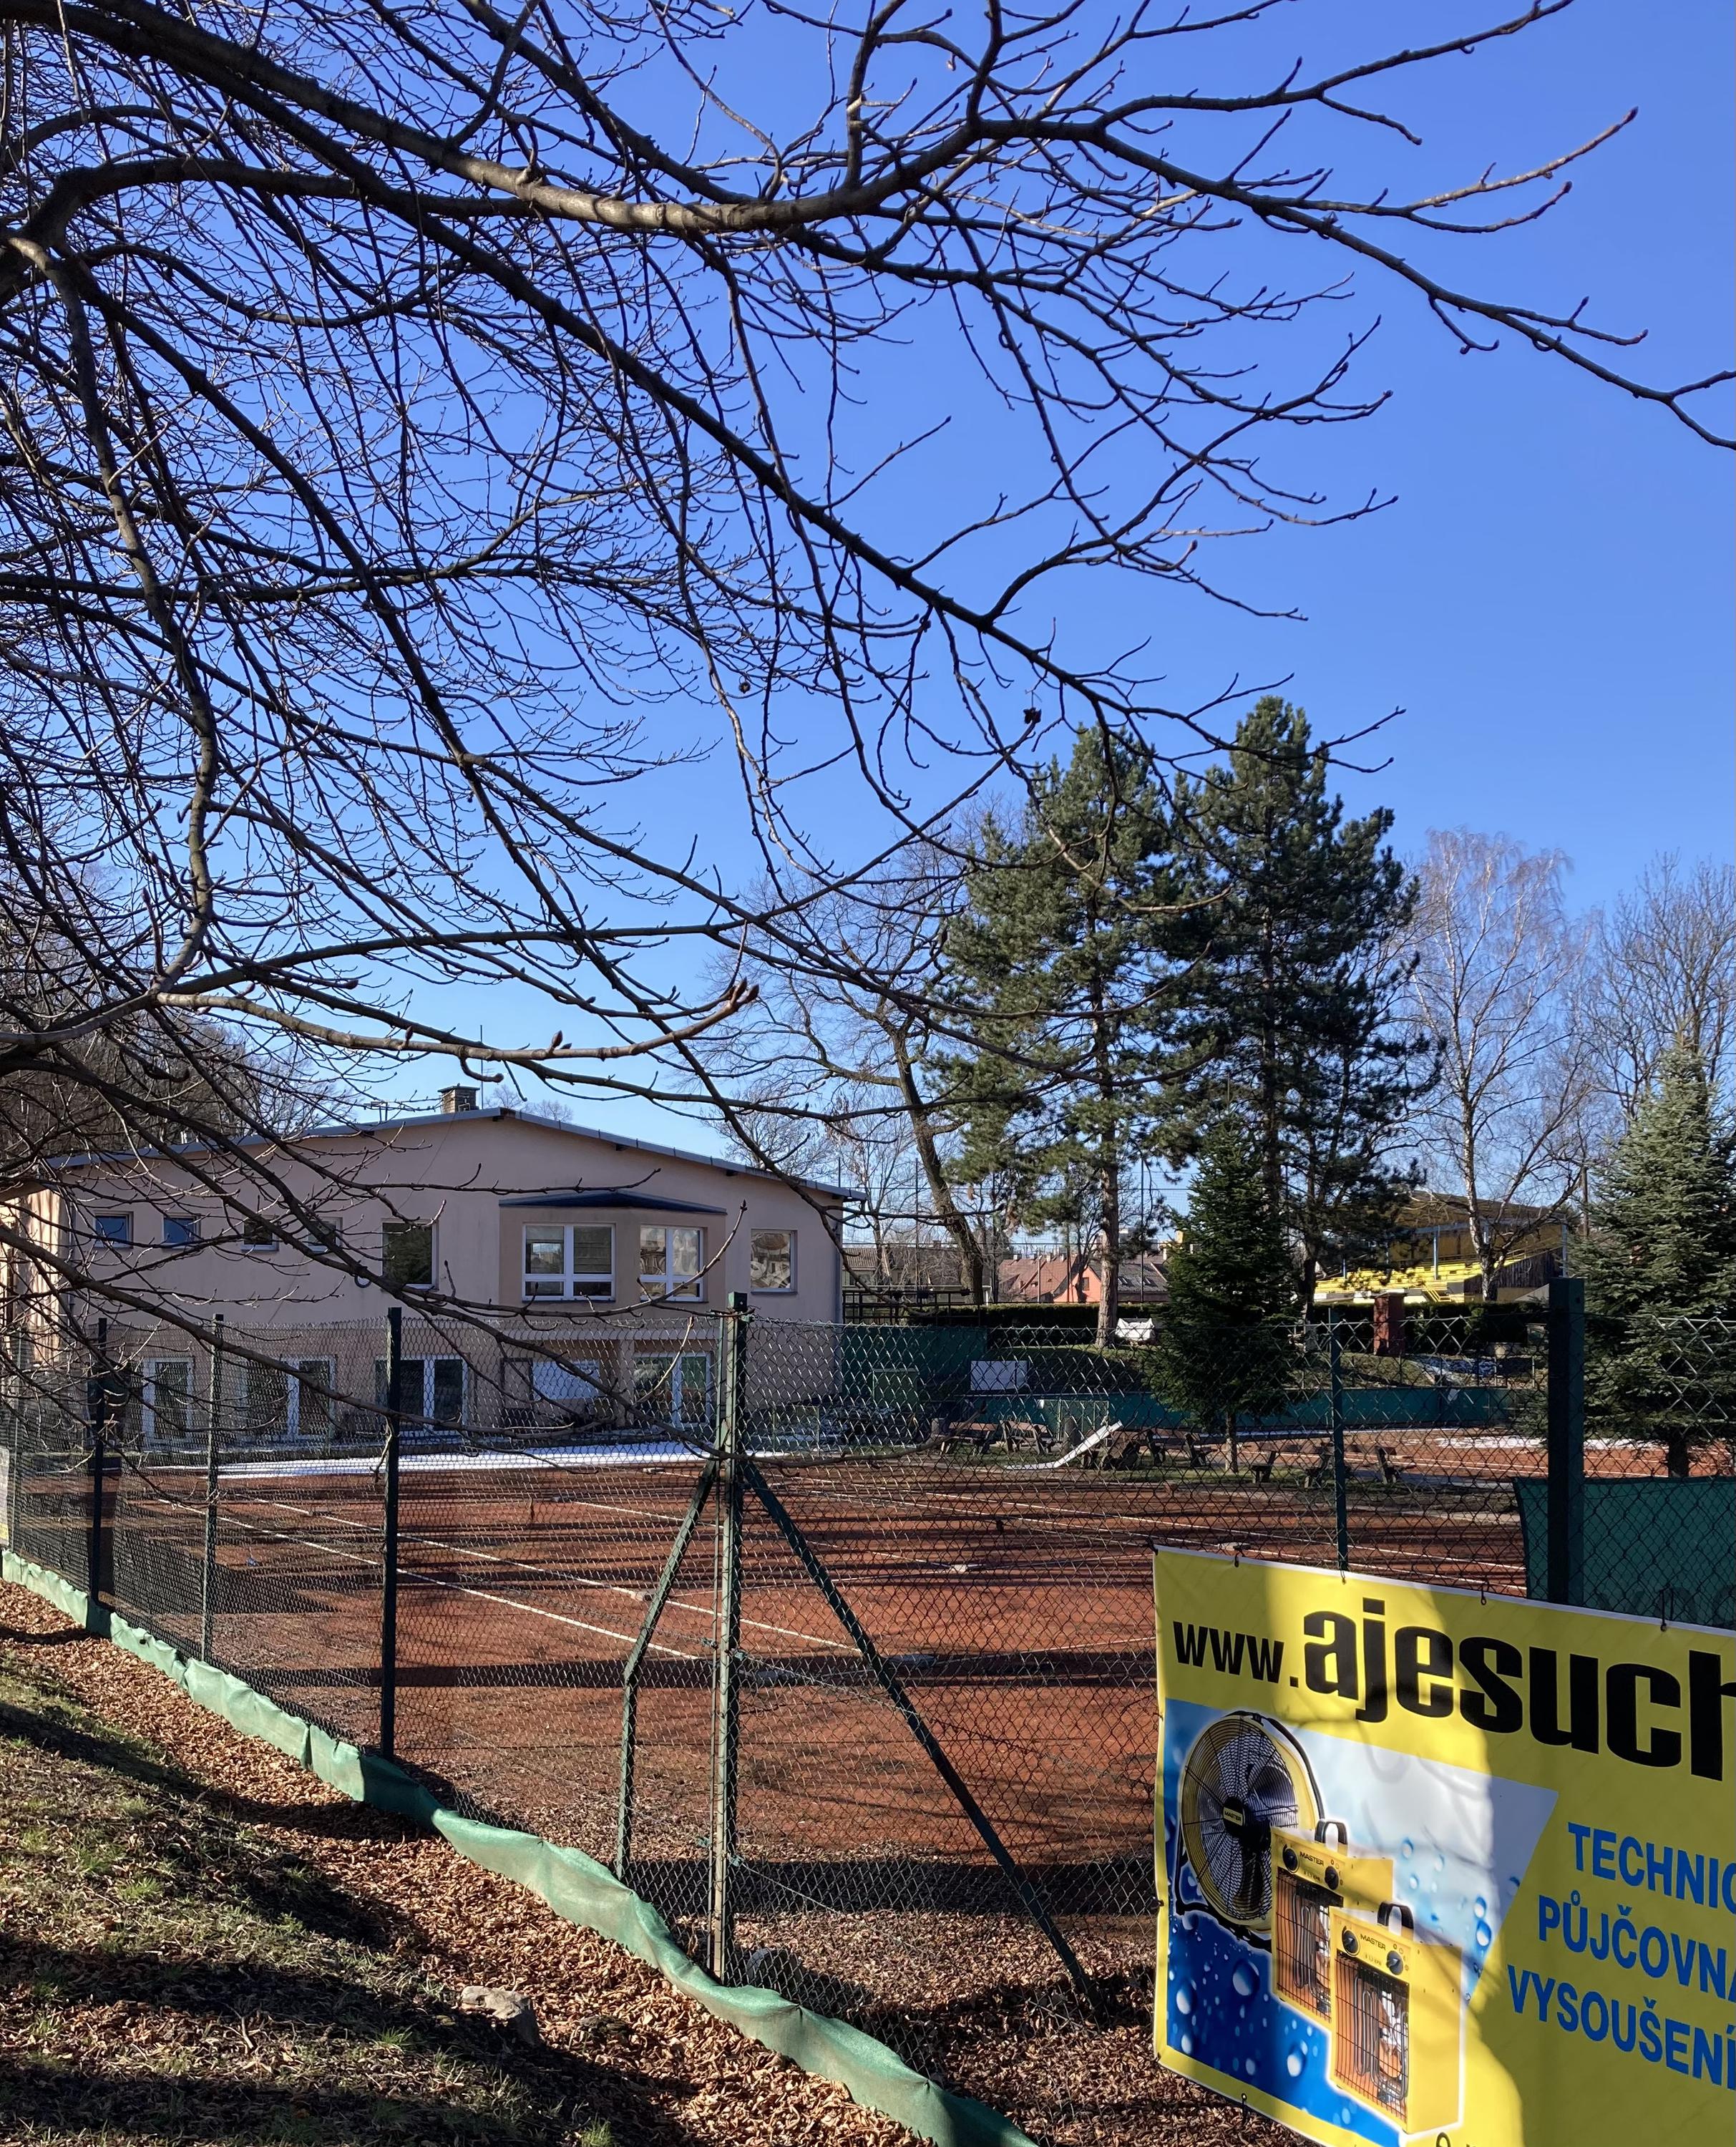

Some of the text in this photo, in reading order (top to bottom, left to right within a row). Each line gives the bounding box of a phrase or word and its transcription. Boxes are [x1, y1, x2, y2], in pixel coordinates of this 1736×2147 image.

[1173, 1597, 1736, 1781] www.ajesuch
[1224, 1811, 1242, 1822] MASTER
[1299, 1851, 1324, 1866] MASTER
[1360, 1934, 1386, 1951] MASTER
[1507, 1964, 1736, 2090] VYSOUŠENÍ
